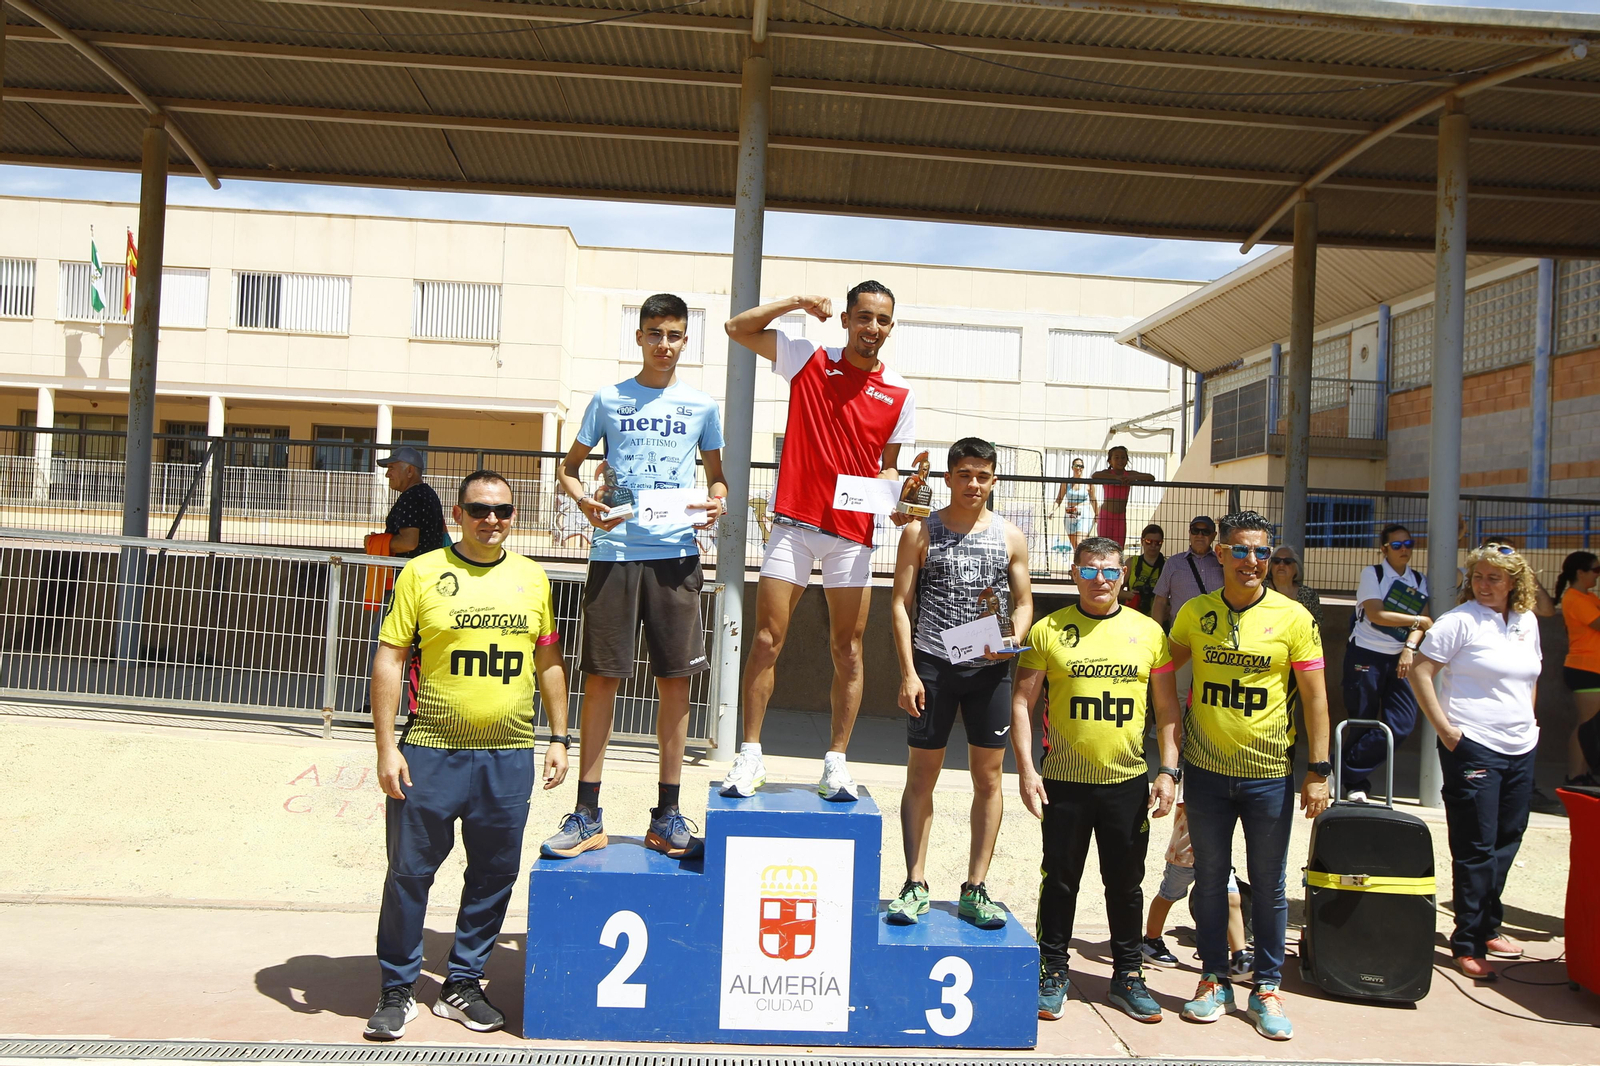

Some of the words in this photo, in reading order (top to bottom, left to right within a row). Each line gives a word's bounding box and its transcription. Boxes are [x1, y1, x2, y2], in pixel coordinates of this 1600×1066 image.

[620, 414, 687, 437] nerja
[630, 438, 677, 448] ATLETISMO
[454, 613, 528, 629] SPORTGYM
[450, 643, 524, 685] mtp
[1071, 664, 1138, 678] SPORTGYM
[1205, 650, 1272, 668] SPORTGYM
[1070, 691, 1135, 728] mtp
[1201, 678, 1268, 717] mtp
[597, 909, 649, 1008] 2
[729, 971, 841, 996] ALMERÍA
[756, 998, 814, 1012] CIUDAD
[925, 955, 974, 1037] 3
